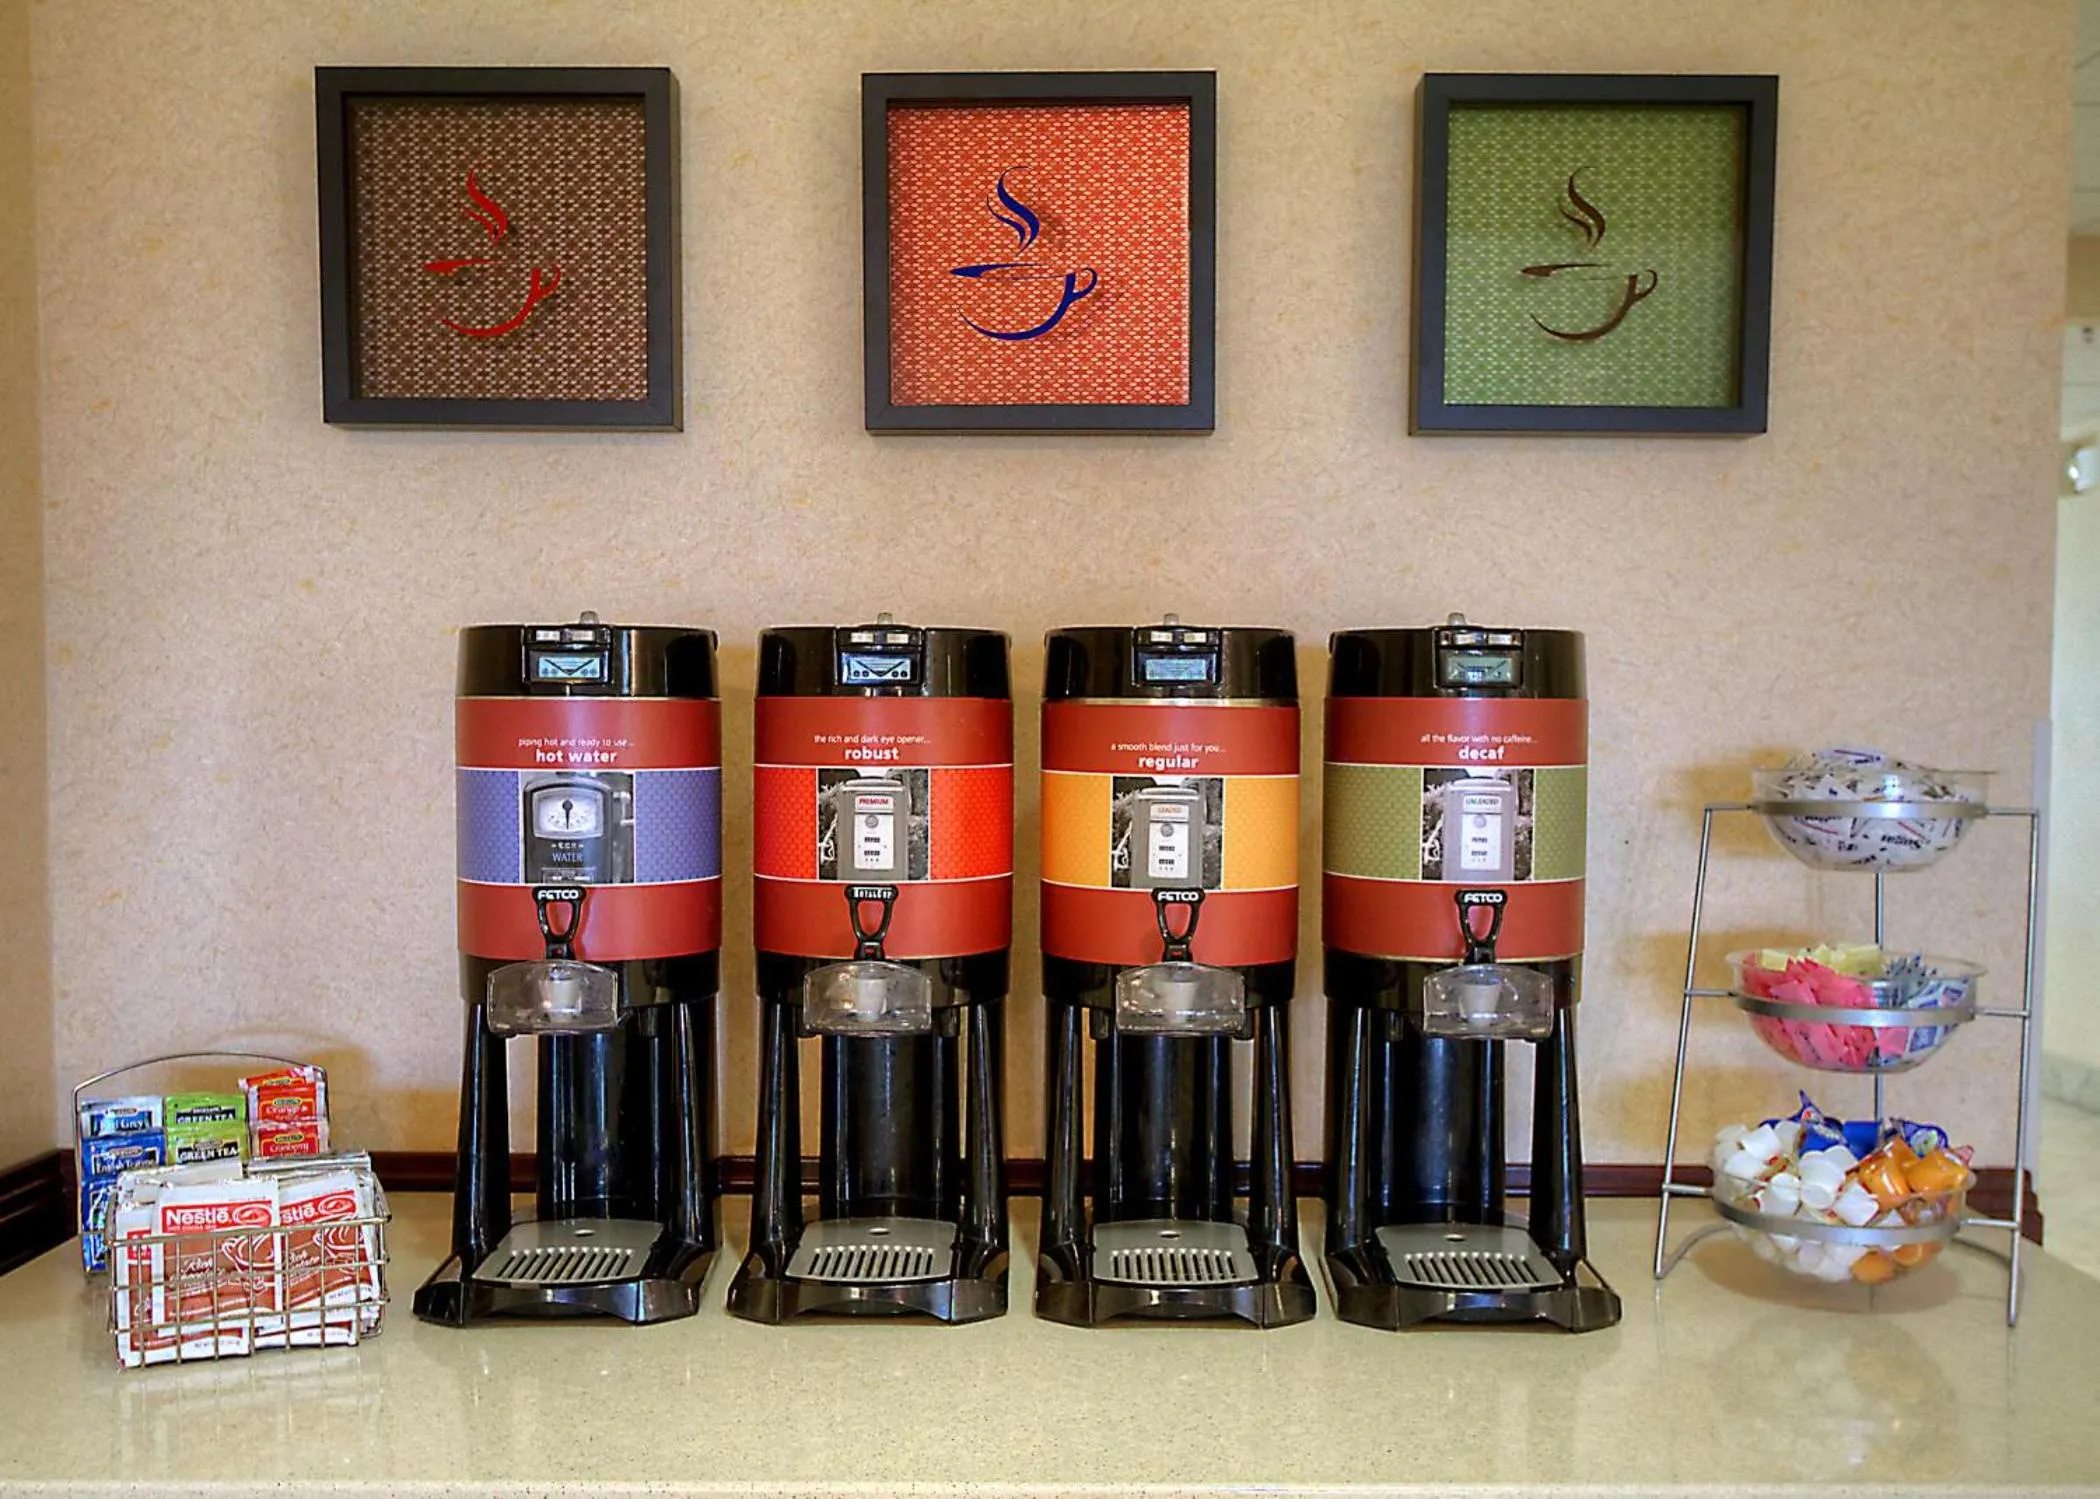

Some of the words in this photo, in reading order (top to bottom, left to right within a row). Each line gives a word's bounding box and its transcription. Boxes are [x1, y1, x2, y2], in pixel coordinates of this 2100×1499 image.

[518, 738, 542, 748] piping
[544, 738, 558, 747] hot
[560, 739, 576, 747] and
[578, 739, 600, 748] ready
[602, 738, 611, 747] to
[814, 735, 826, 743] the
[828, 735, 842, 743] rich
[844, 735, 858, 743] and
[860, 735, 879, 743] dark
[880, 736, 895, 745] eye
[1420, 734, 1431, 743] all
[1432, 734, 1446, 743] the
[1447, 734, 1470, 743] flavor
[1471, 734, 1489, 743] with
[844, 745, 899, 760] robust
[1118, 743, 1147, 751] smooth
[1149, 743, 1172, 751] blend
[1173, 743, 1189, 753] just
[1191, 743, 1204, 752] for
[1458, 745, 1505, 760] decaf
[535, 748, 564, 763] hot
[567, 751, 618, 763] water
[1138, 754, 1199, 771] regular
[551, 852, 583, 863] WATER
[537, 889, 579, 901] FETCO
[1157, 891, 1199, 902] FETCO
[1463, 893, 1503, 903] FETCO
[177, 1114, 213, 1124] GREEN
[214, 1111, 234, 1121] TEA
[180, 1149, 216, 1161] GREEN
[217, 1145, 238, 1157] TEA
